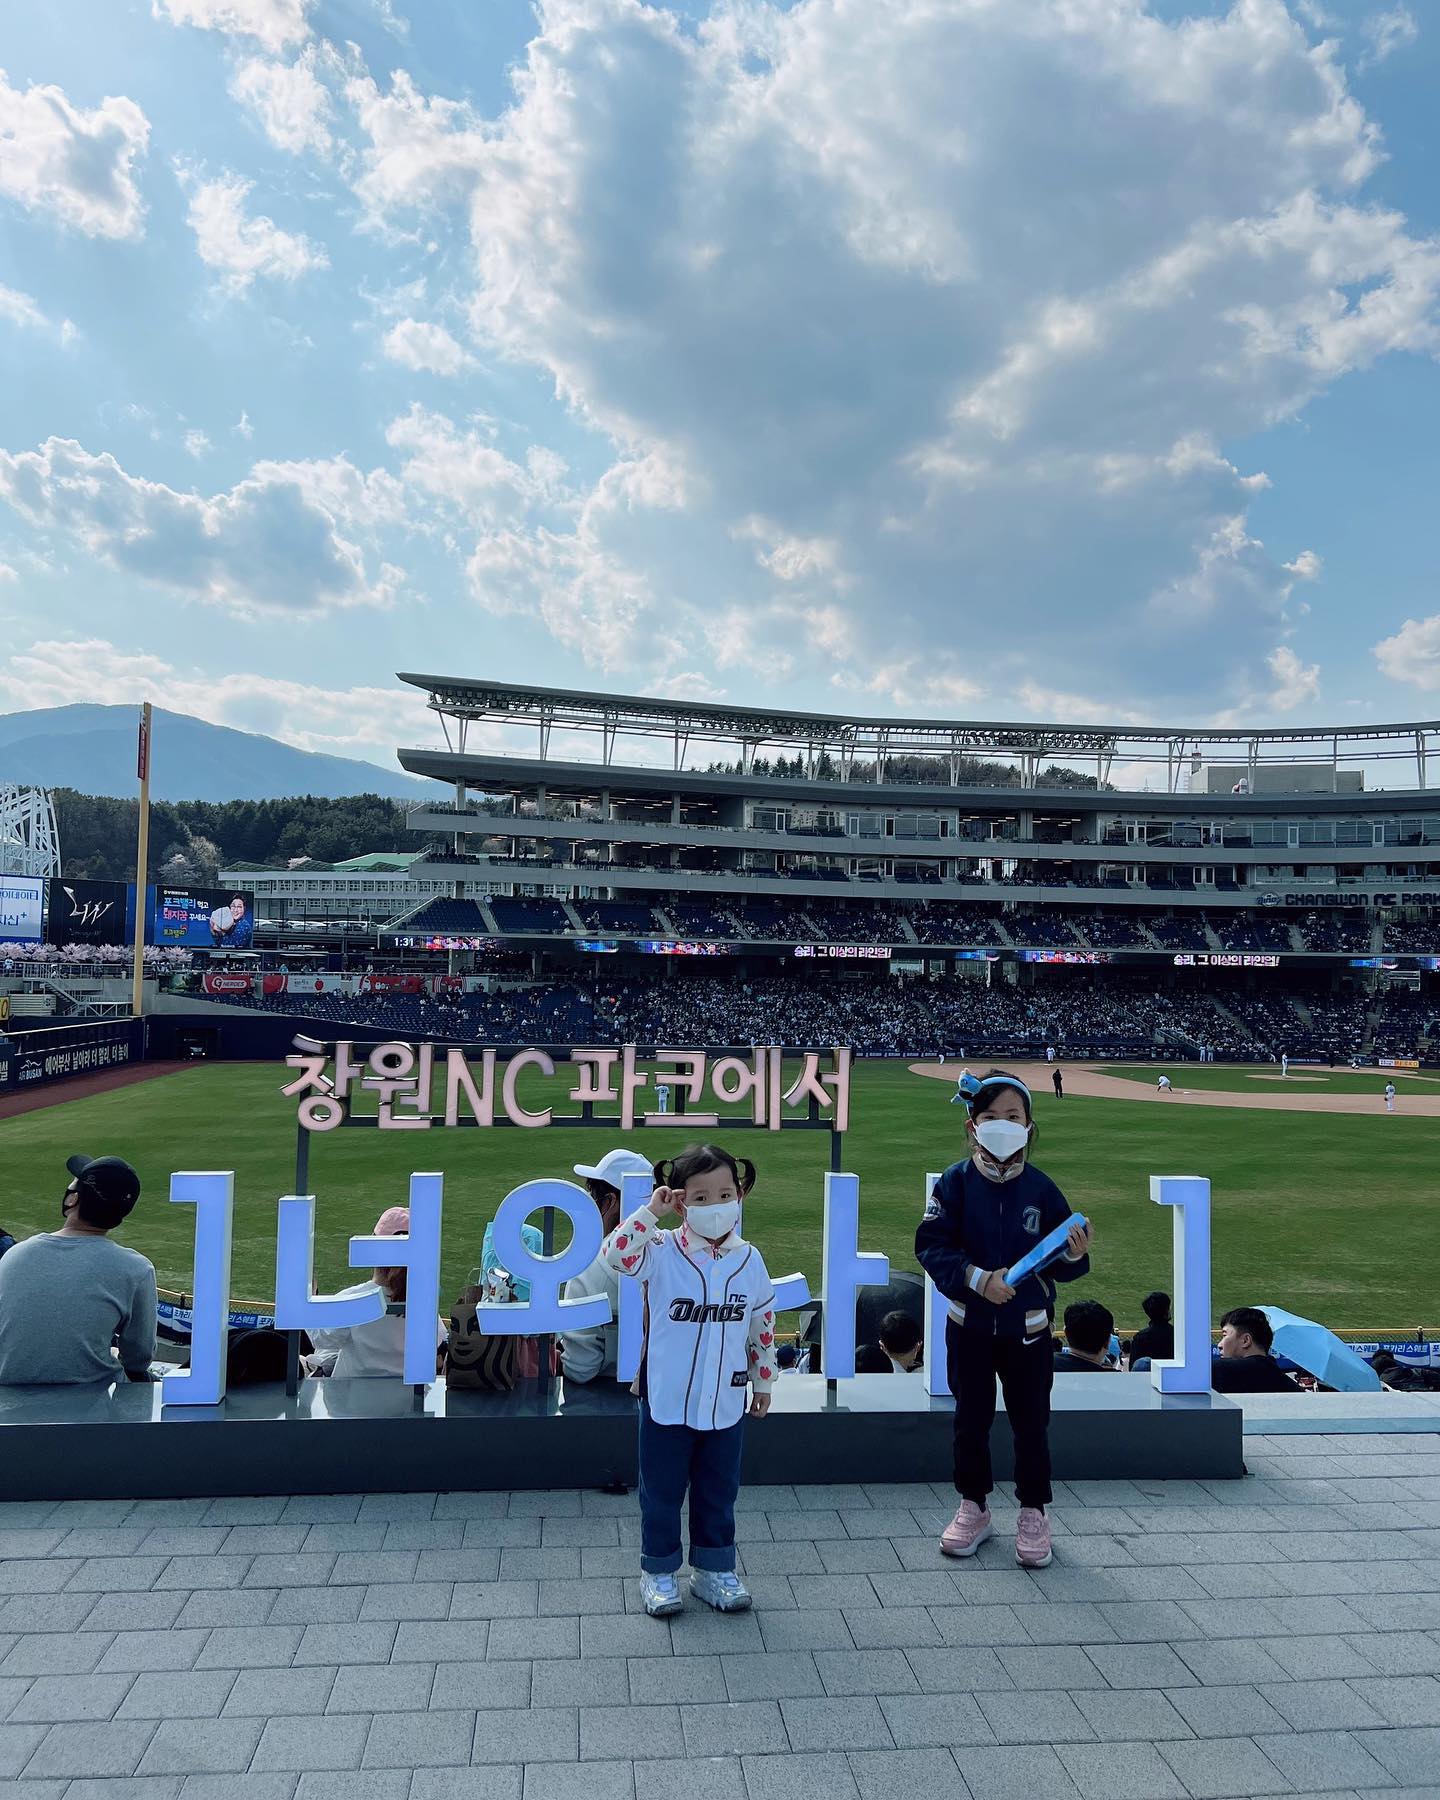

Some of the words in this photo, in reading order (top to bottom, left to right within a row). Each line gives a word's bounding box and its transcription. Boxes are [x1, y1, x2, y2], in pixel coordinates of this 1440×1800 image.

[163, 897, 196, 909] 포크밸리
[1285, 893, 1368, 905] CHANGWON
[394, 937, 414, 947] 1:31
[794, 946, 816, 957] 승리,
[817, 946, 828, 957] 그
[829, 946, 857, 958] 이상의
[858, 947, 892, 959] 라인업!
[1173, 954, 1196, 966] 승리,
[1197, 955, 1209, 965] 그
[1210, 955, 1242, 966] 이상의
[1243, 955, 1280, 967] 라인업!
[45, 1052, 70, 1075] 에어부산
[72, 1049, 90, 1070] 날아라
[91, 1048, 98, 1066] 더
[112, 1044, 118, 1061] 더
[26, 1068, 43, 1080] BUSAN
[728, 1293, 747, 1303] NC
